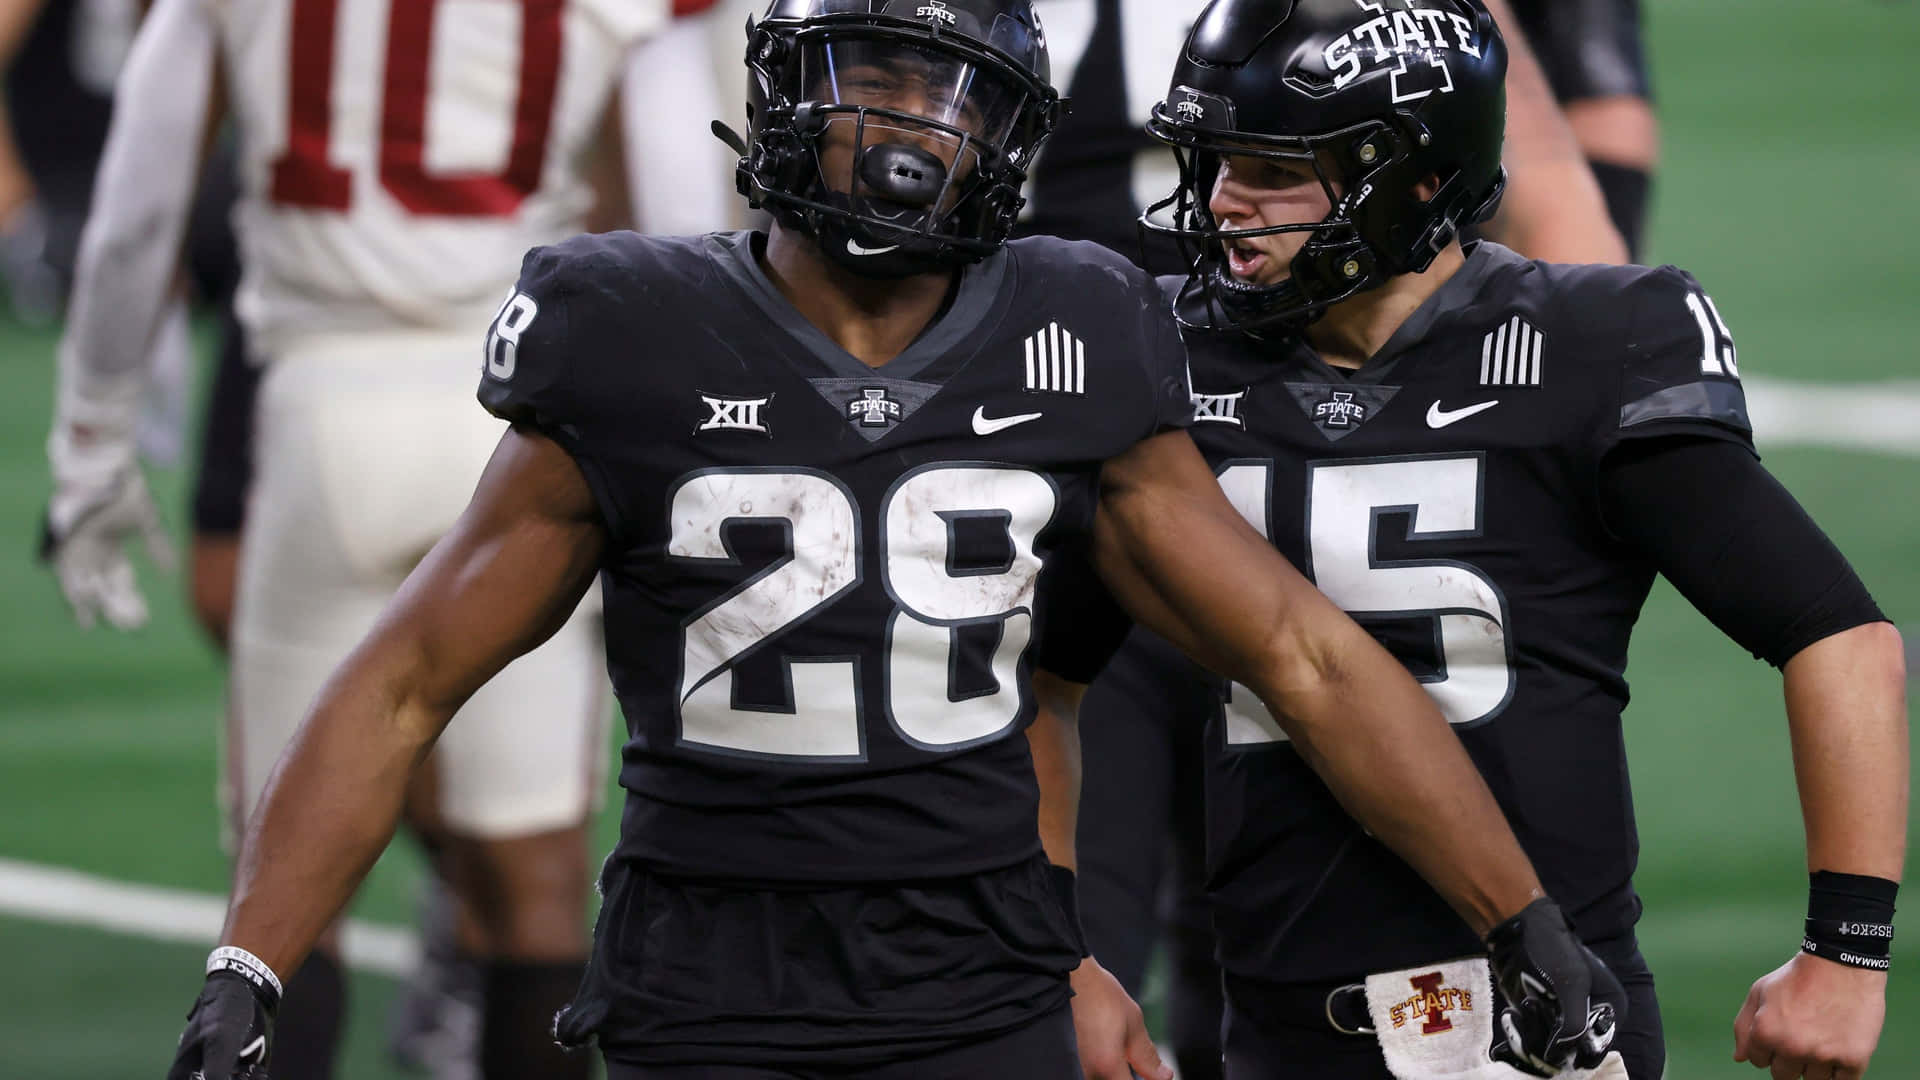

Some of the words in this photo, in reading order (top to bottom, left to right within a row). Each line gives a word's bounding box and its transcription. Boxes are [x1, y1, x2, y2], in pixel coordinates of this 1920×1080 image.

[916, 6, 956, 24] STATE
[1324, 9, 1482, 90] STATE
[271, 0, 562, 217] 10
[1176, 101, 1204, 119] STATE
[483, 284, 538, 380] 8
[700, 395, 768, 433] XII
[850, 399, 900, 417] STATE
[1191, 390, 1244, 425] XII
[1316, 403, 1364, 419] STATE
[667, 466, 1057, 760] 28
[228, 959, 264, 987] BLACK
[1840, 952, 1889, 969] COMMAND
[1389, 988, 1474, 1030] STATE
